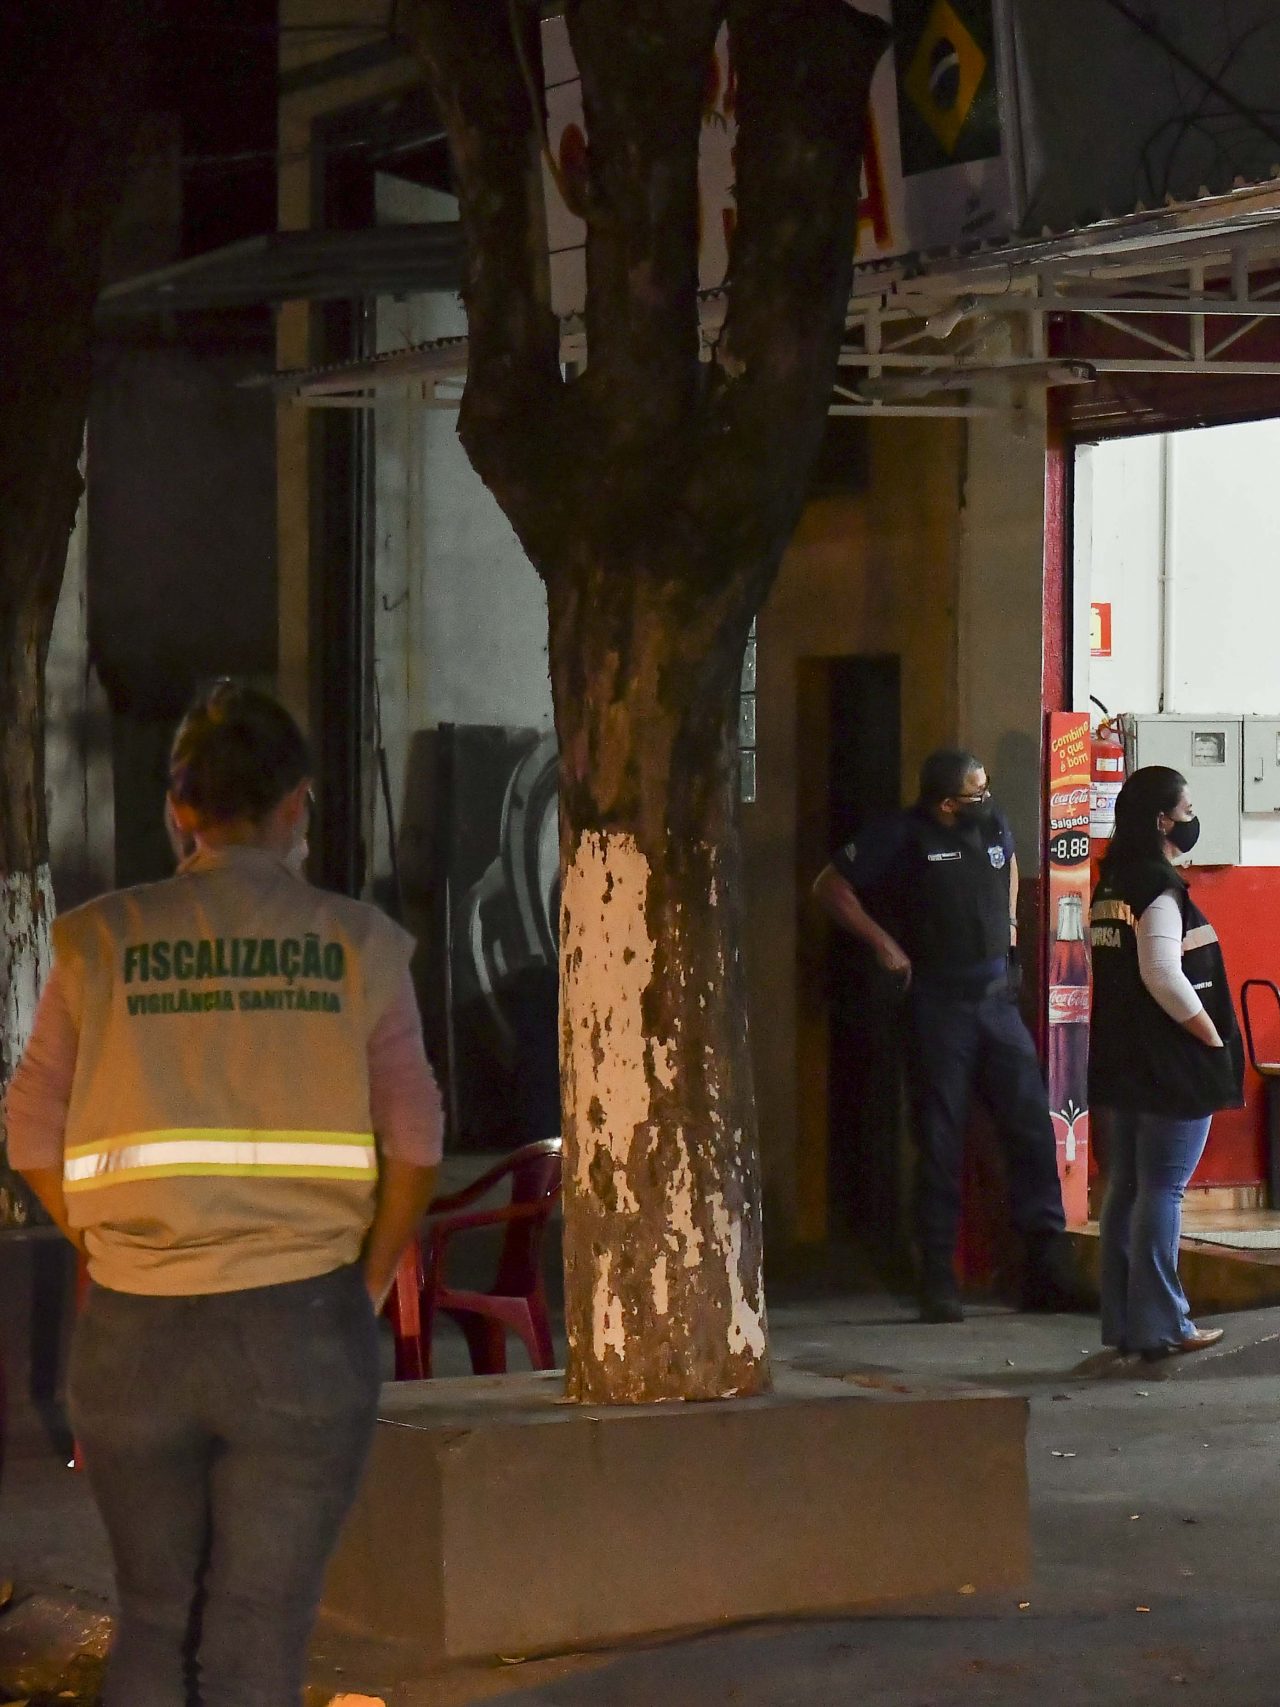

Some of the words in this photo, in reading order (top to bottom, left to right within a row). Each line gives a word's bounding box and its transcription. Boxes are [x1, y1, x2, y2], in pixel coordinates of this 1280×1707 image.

[1060, 748, 1066, 759] o
[1067, 740, 1084, 756] que
[1068, 752, 1088, 768] bom
[1051, 789, 1089, 806] Coca-Cola
[1051, 815, 1089, 830] Salgado
[124, 932, 346, 986] FISCALIZAÇÃO
[127, 988, 234, 1016] VIGILÂNCIA
[238, 987, 341, 1013] SANITÁRIA
